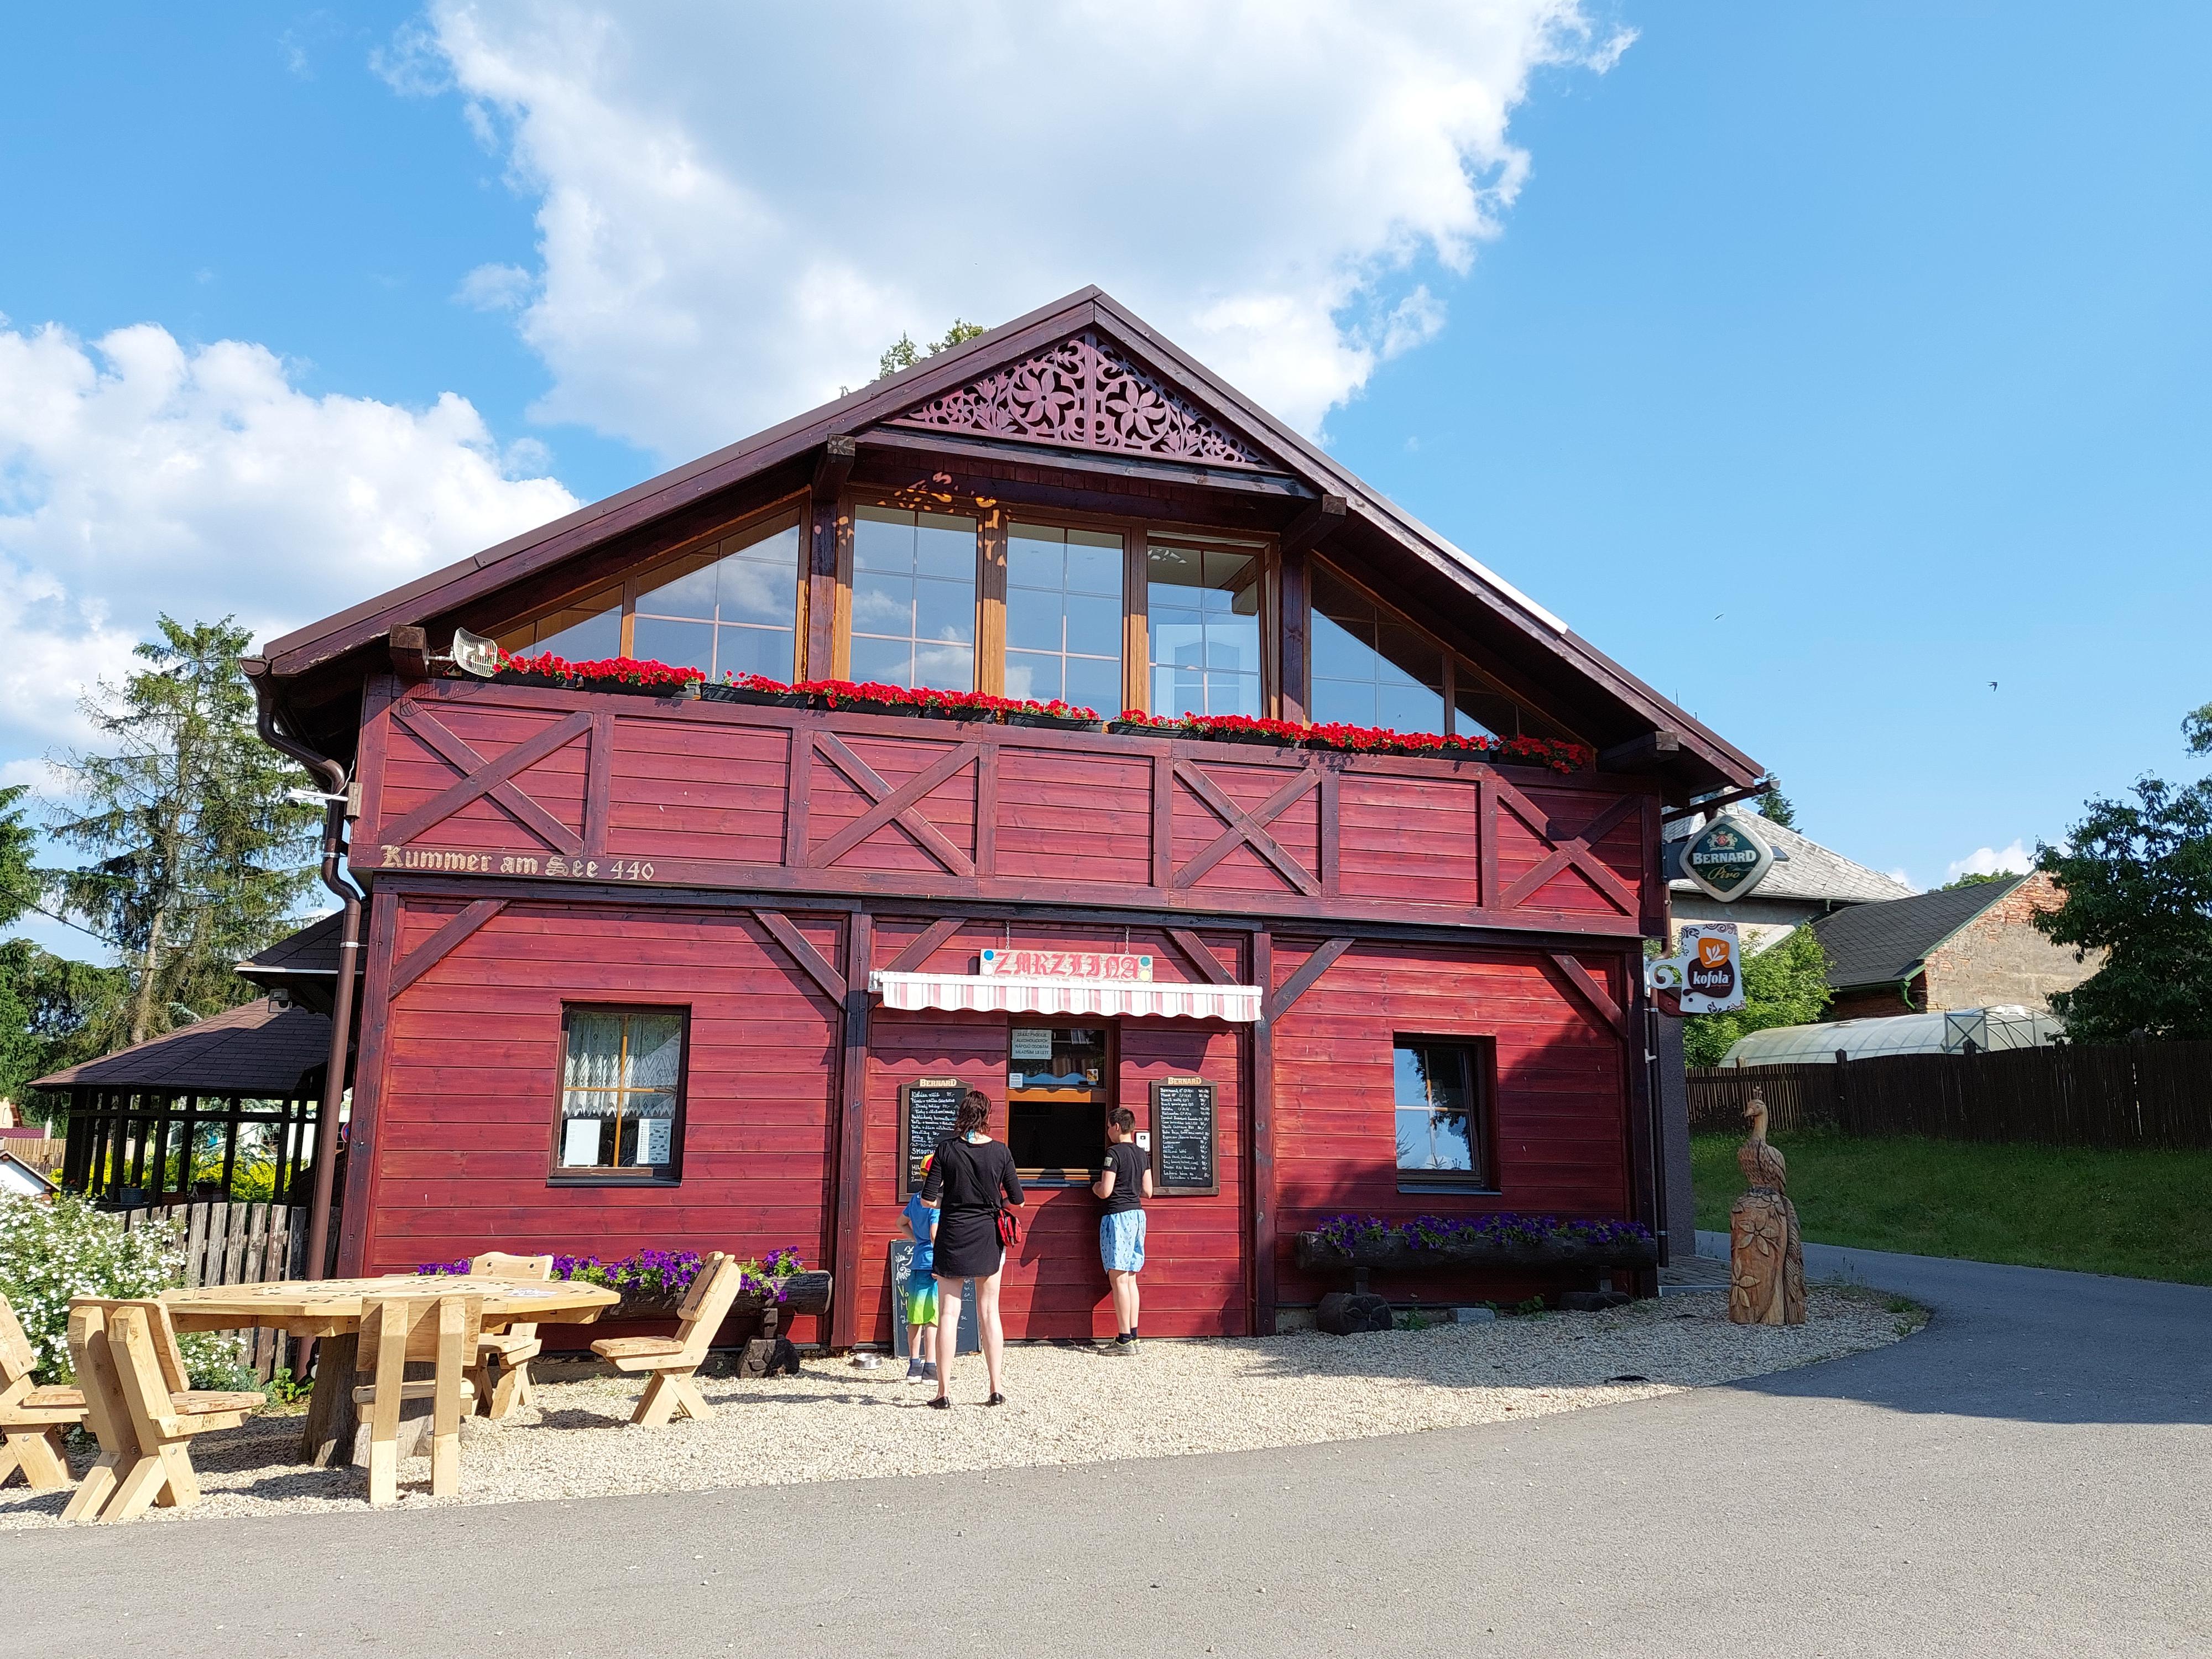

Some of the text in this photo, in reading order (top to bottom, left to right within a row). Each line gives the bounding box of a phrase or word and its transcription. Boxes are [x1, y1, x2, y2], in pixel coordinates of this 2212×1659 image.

[1692, 849, 1757, 865] BERNARD
[500, 855, 538, 875] am
[544, 856, 599, 878] See
[609, 860, 655, 880] 440
[1707, 864, 1740, 880] Pivo
[1693, 970, 1729, 988] kofola
[920, 1079, 957, 1087] BERNARD
